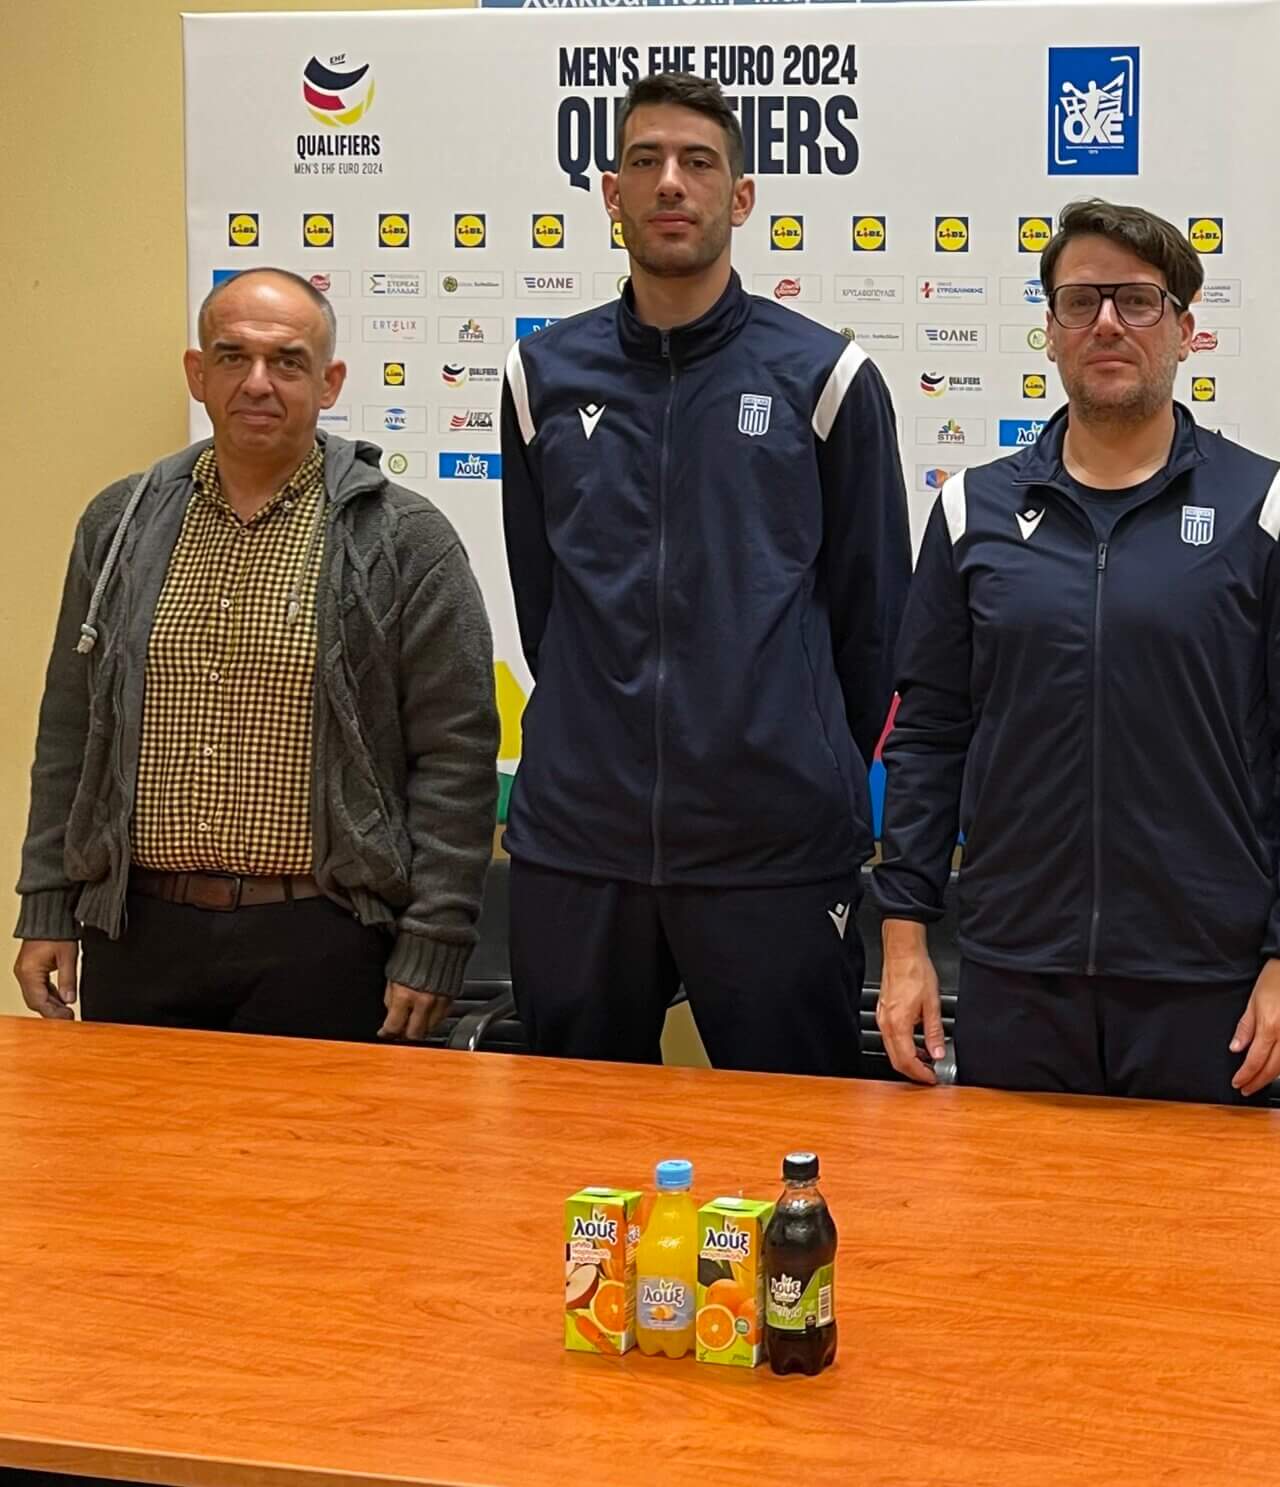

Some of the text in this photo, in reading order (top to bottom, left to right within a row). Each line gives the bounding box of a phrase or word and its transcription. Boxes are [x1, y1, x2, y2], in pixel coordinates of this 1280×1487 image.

[558, 45, 858, 87] MEN'S EHF EURO 2024
[296, 134, 381, 157] QUALIFIERS
[557, 94, 858, 191] QUIERS
[294, 162, 384, 175] MEN'S EHF EURO 2024
